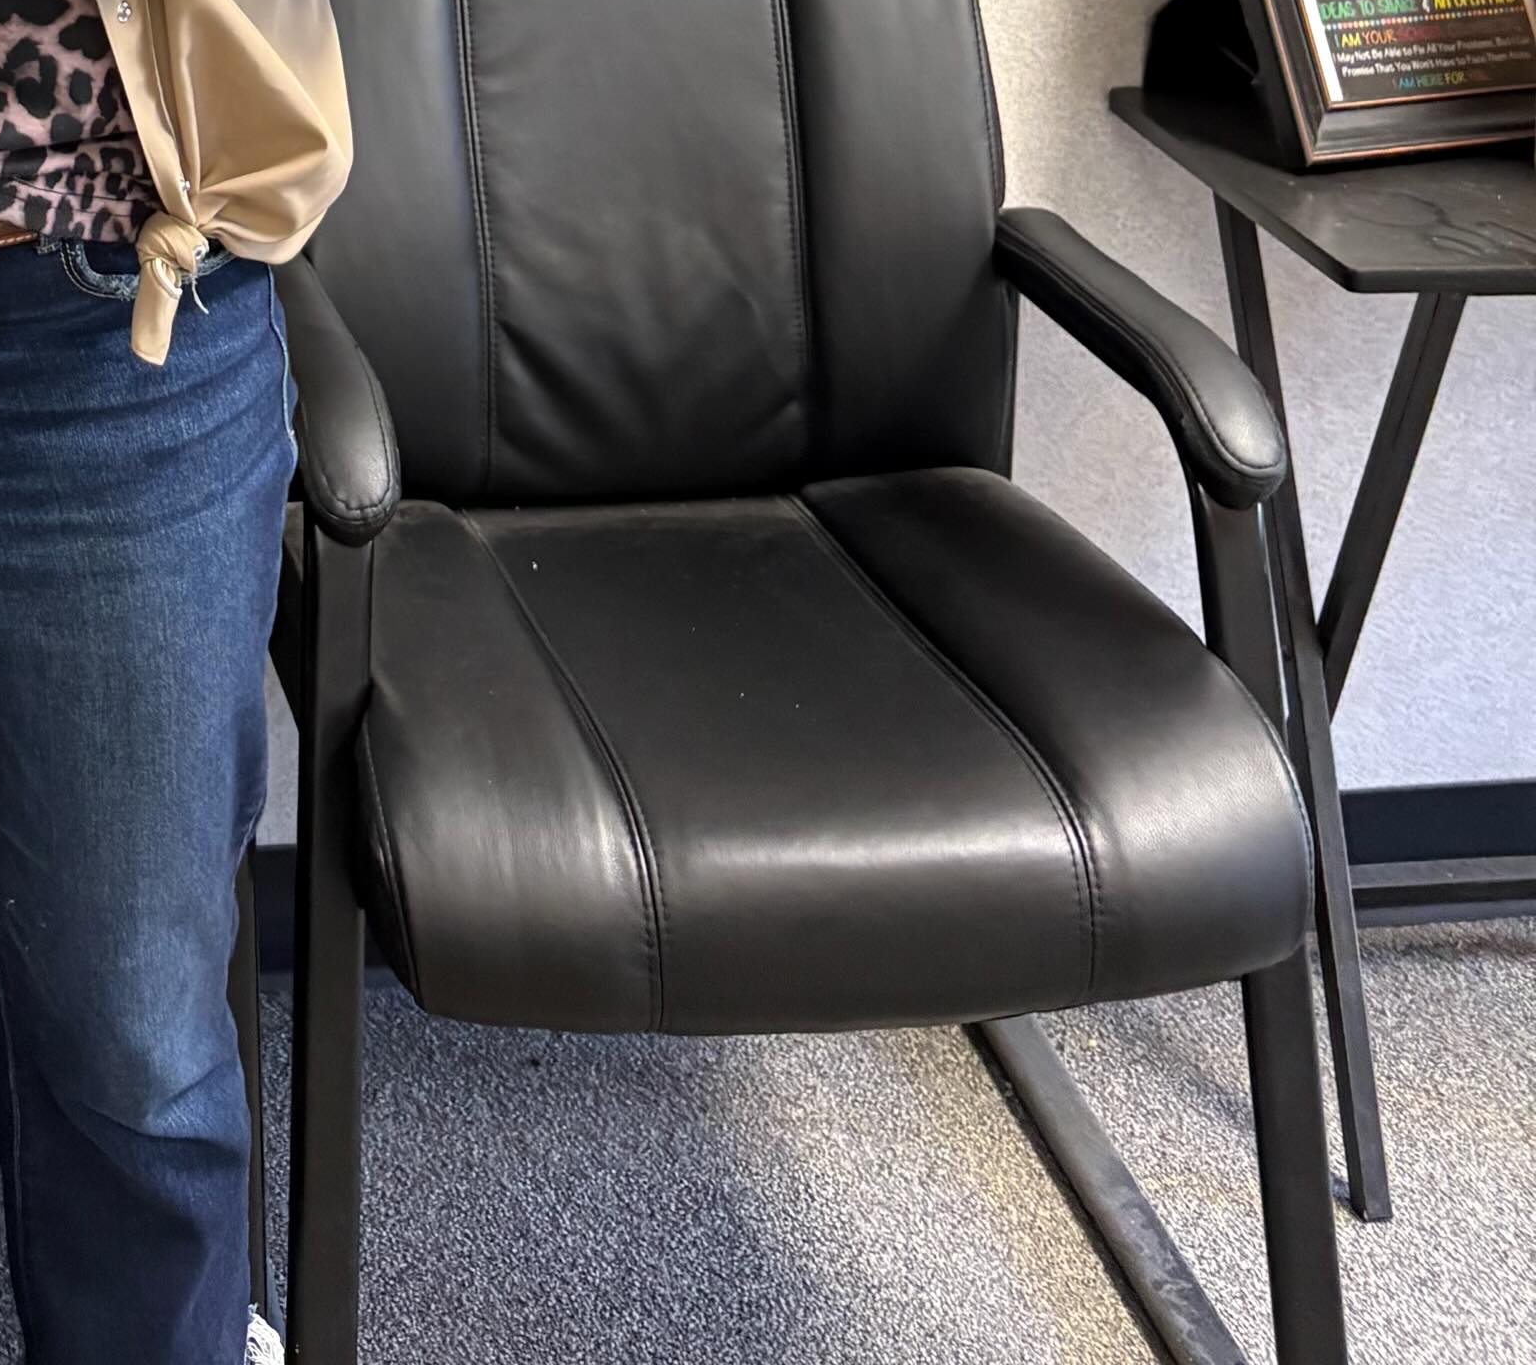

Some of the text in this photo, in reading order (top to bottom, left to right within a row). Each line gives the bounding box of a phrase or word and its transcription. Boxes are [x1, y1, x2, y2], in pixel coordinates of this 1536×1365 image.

[1319, 0, 1356, 20] IDEAS
[1357, 0, 1374, 15] TO
[1335, 34, 1340, 48] I
[1341, 33, 1361, 46] AM
[1362, 29, 1397, 44] YOUR
[1399, 75, 1415, 87] AM
[1445, 70, 1465, 84] FOR
